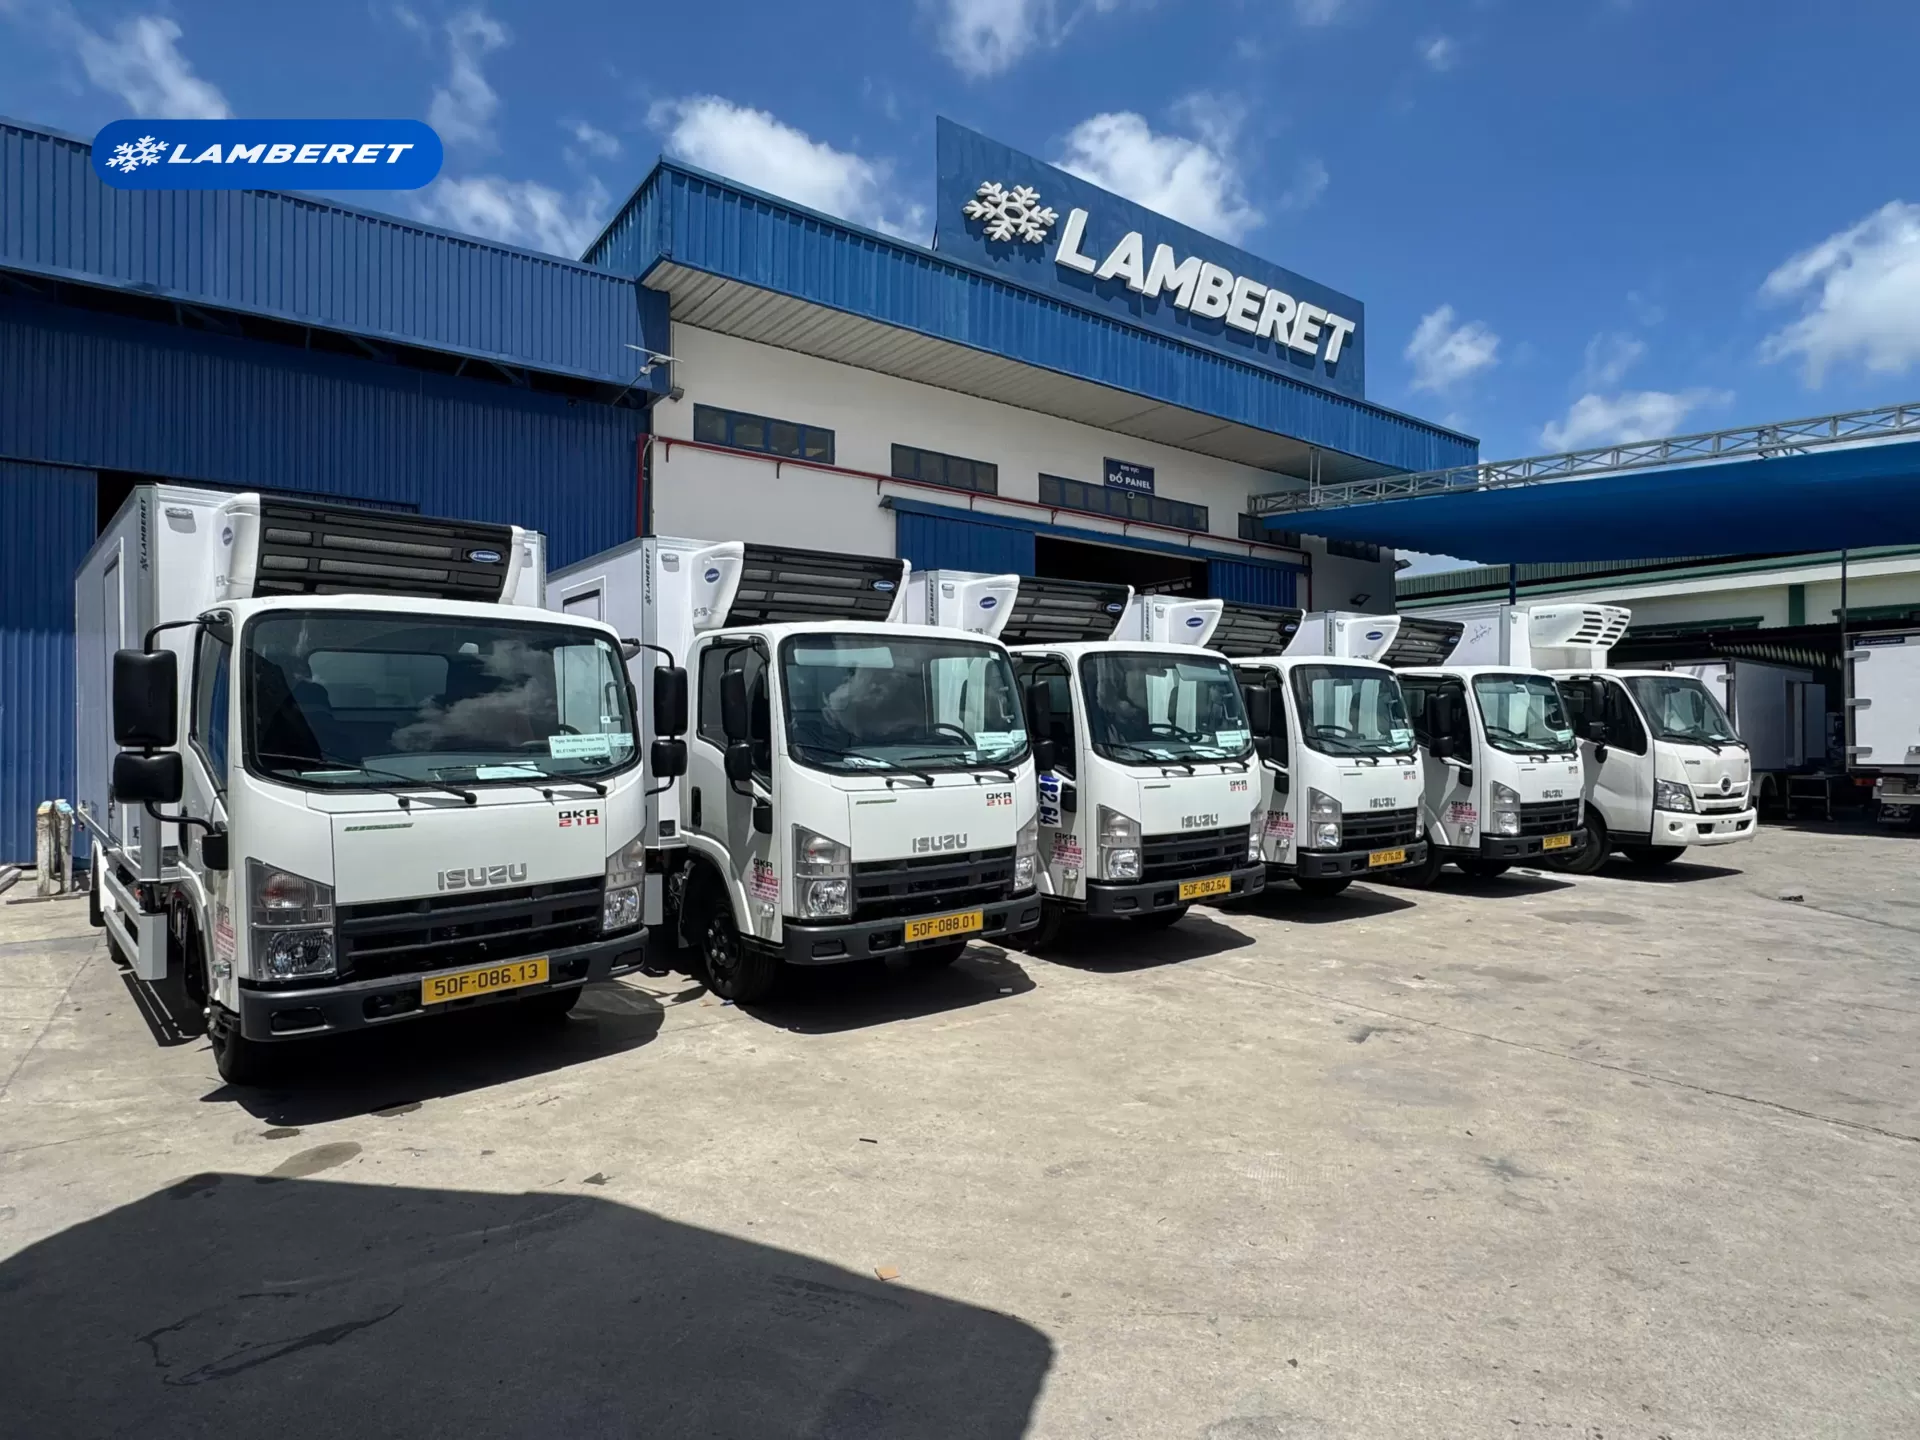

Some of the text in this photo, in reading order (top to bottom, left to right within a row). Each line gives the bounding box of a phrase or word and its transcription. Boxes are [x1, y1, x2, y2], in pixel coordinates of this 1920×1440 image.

[1055, 207, 1356, 363] LAMBERET
[1125, 477, 1151, 489] PANEL
[140, 497, 148, 558] LAMBERET
[986, 792, 1012, 800] QKR
[986, 799, 1013, 807] 210
[1370, 797, 1396, 809] ISUZU
[558, 808, 599, 819] QKR
[558, 817, 599, 828] 210
[1181, 813, 1219, 829] ISUZU
[912, 833, 968, 853] ISUZU
[1054, 833, 1077, 841] QKR
[753, 858, 773, 868] QKR
[437, 862, 528, 891] ISUZU
[1183, 879, 1227, 896] 50F-082.64
[912, 914, 975, 937] 50F-088.01
[434, 963, 538, 997] 50F-086.13
